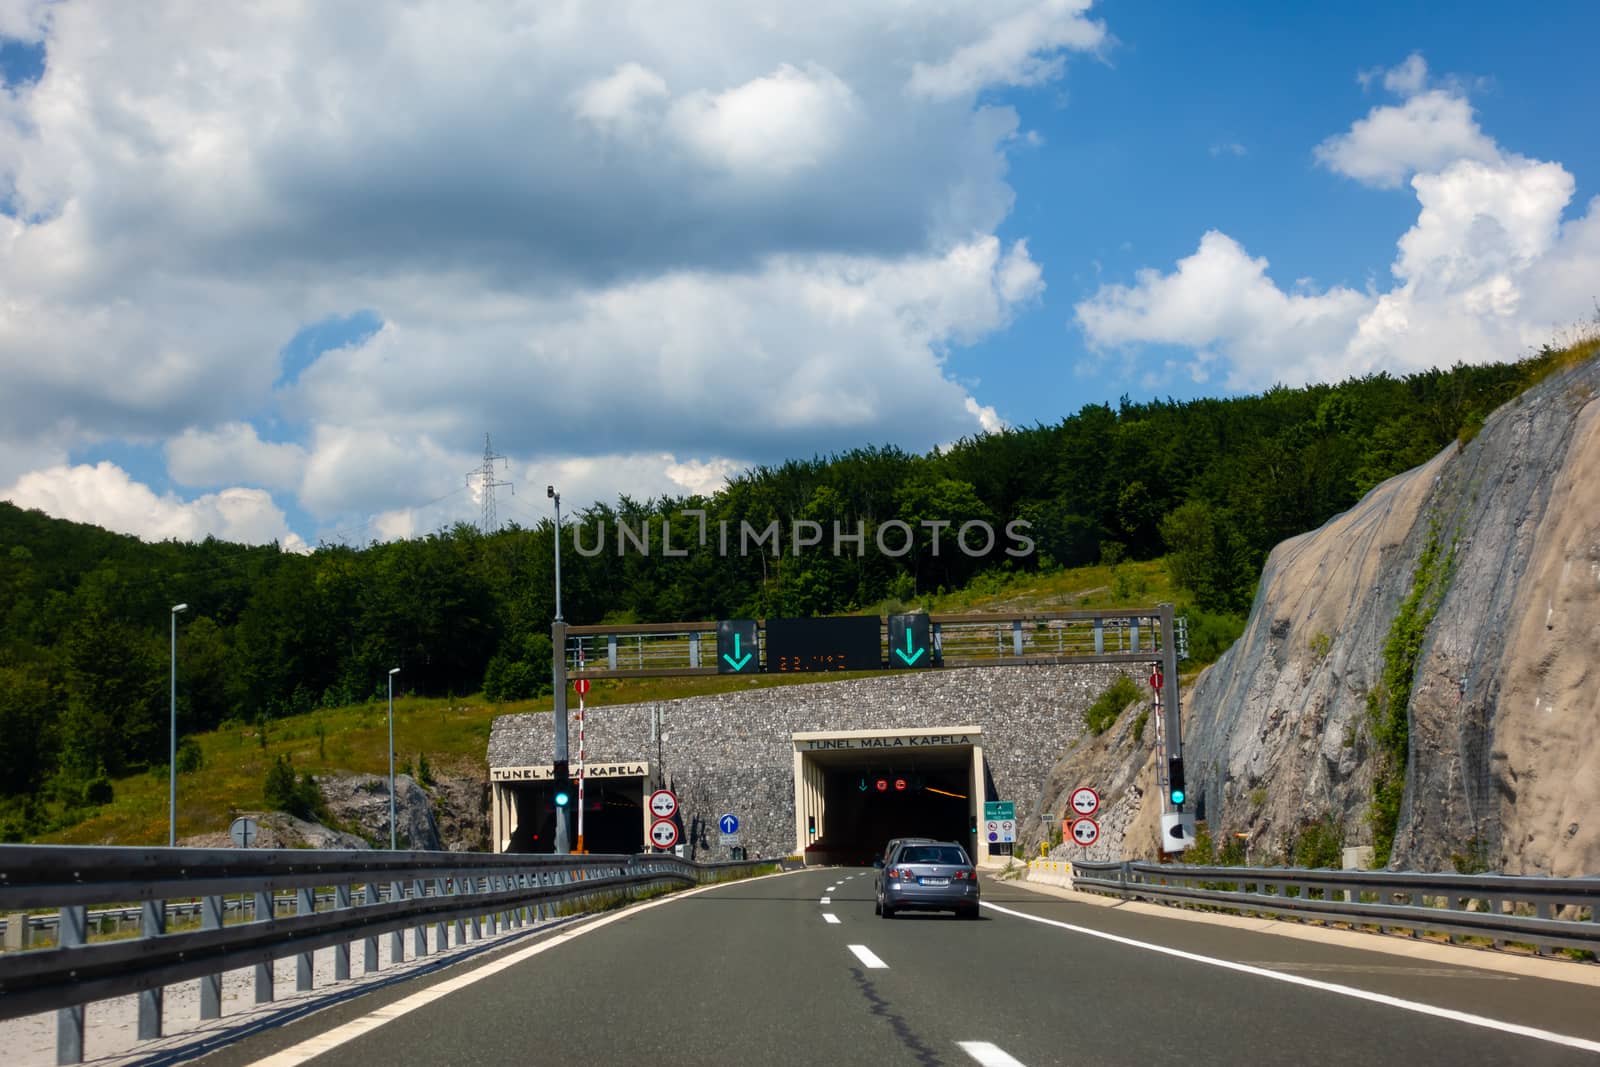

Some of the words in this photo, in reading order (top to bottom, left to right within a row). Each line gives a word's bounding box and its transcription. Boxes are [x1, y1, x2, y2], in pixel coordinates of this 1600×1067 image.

[807, 739, 854, 750] TUNEL
[861, 737, 903, 748] MALA
[909, 735, 970, 747] KAPELA
[493, 769, 540, 779] TUNEL
[546, 767, 584, 777] MA
[589, 765, 645, 776] KAPELA
